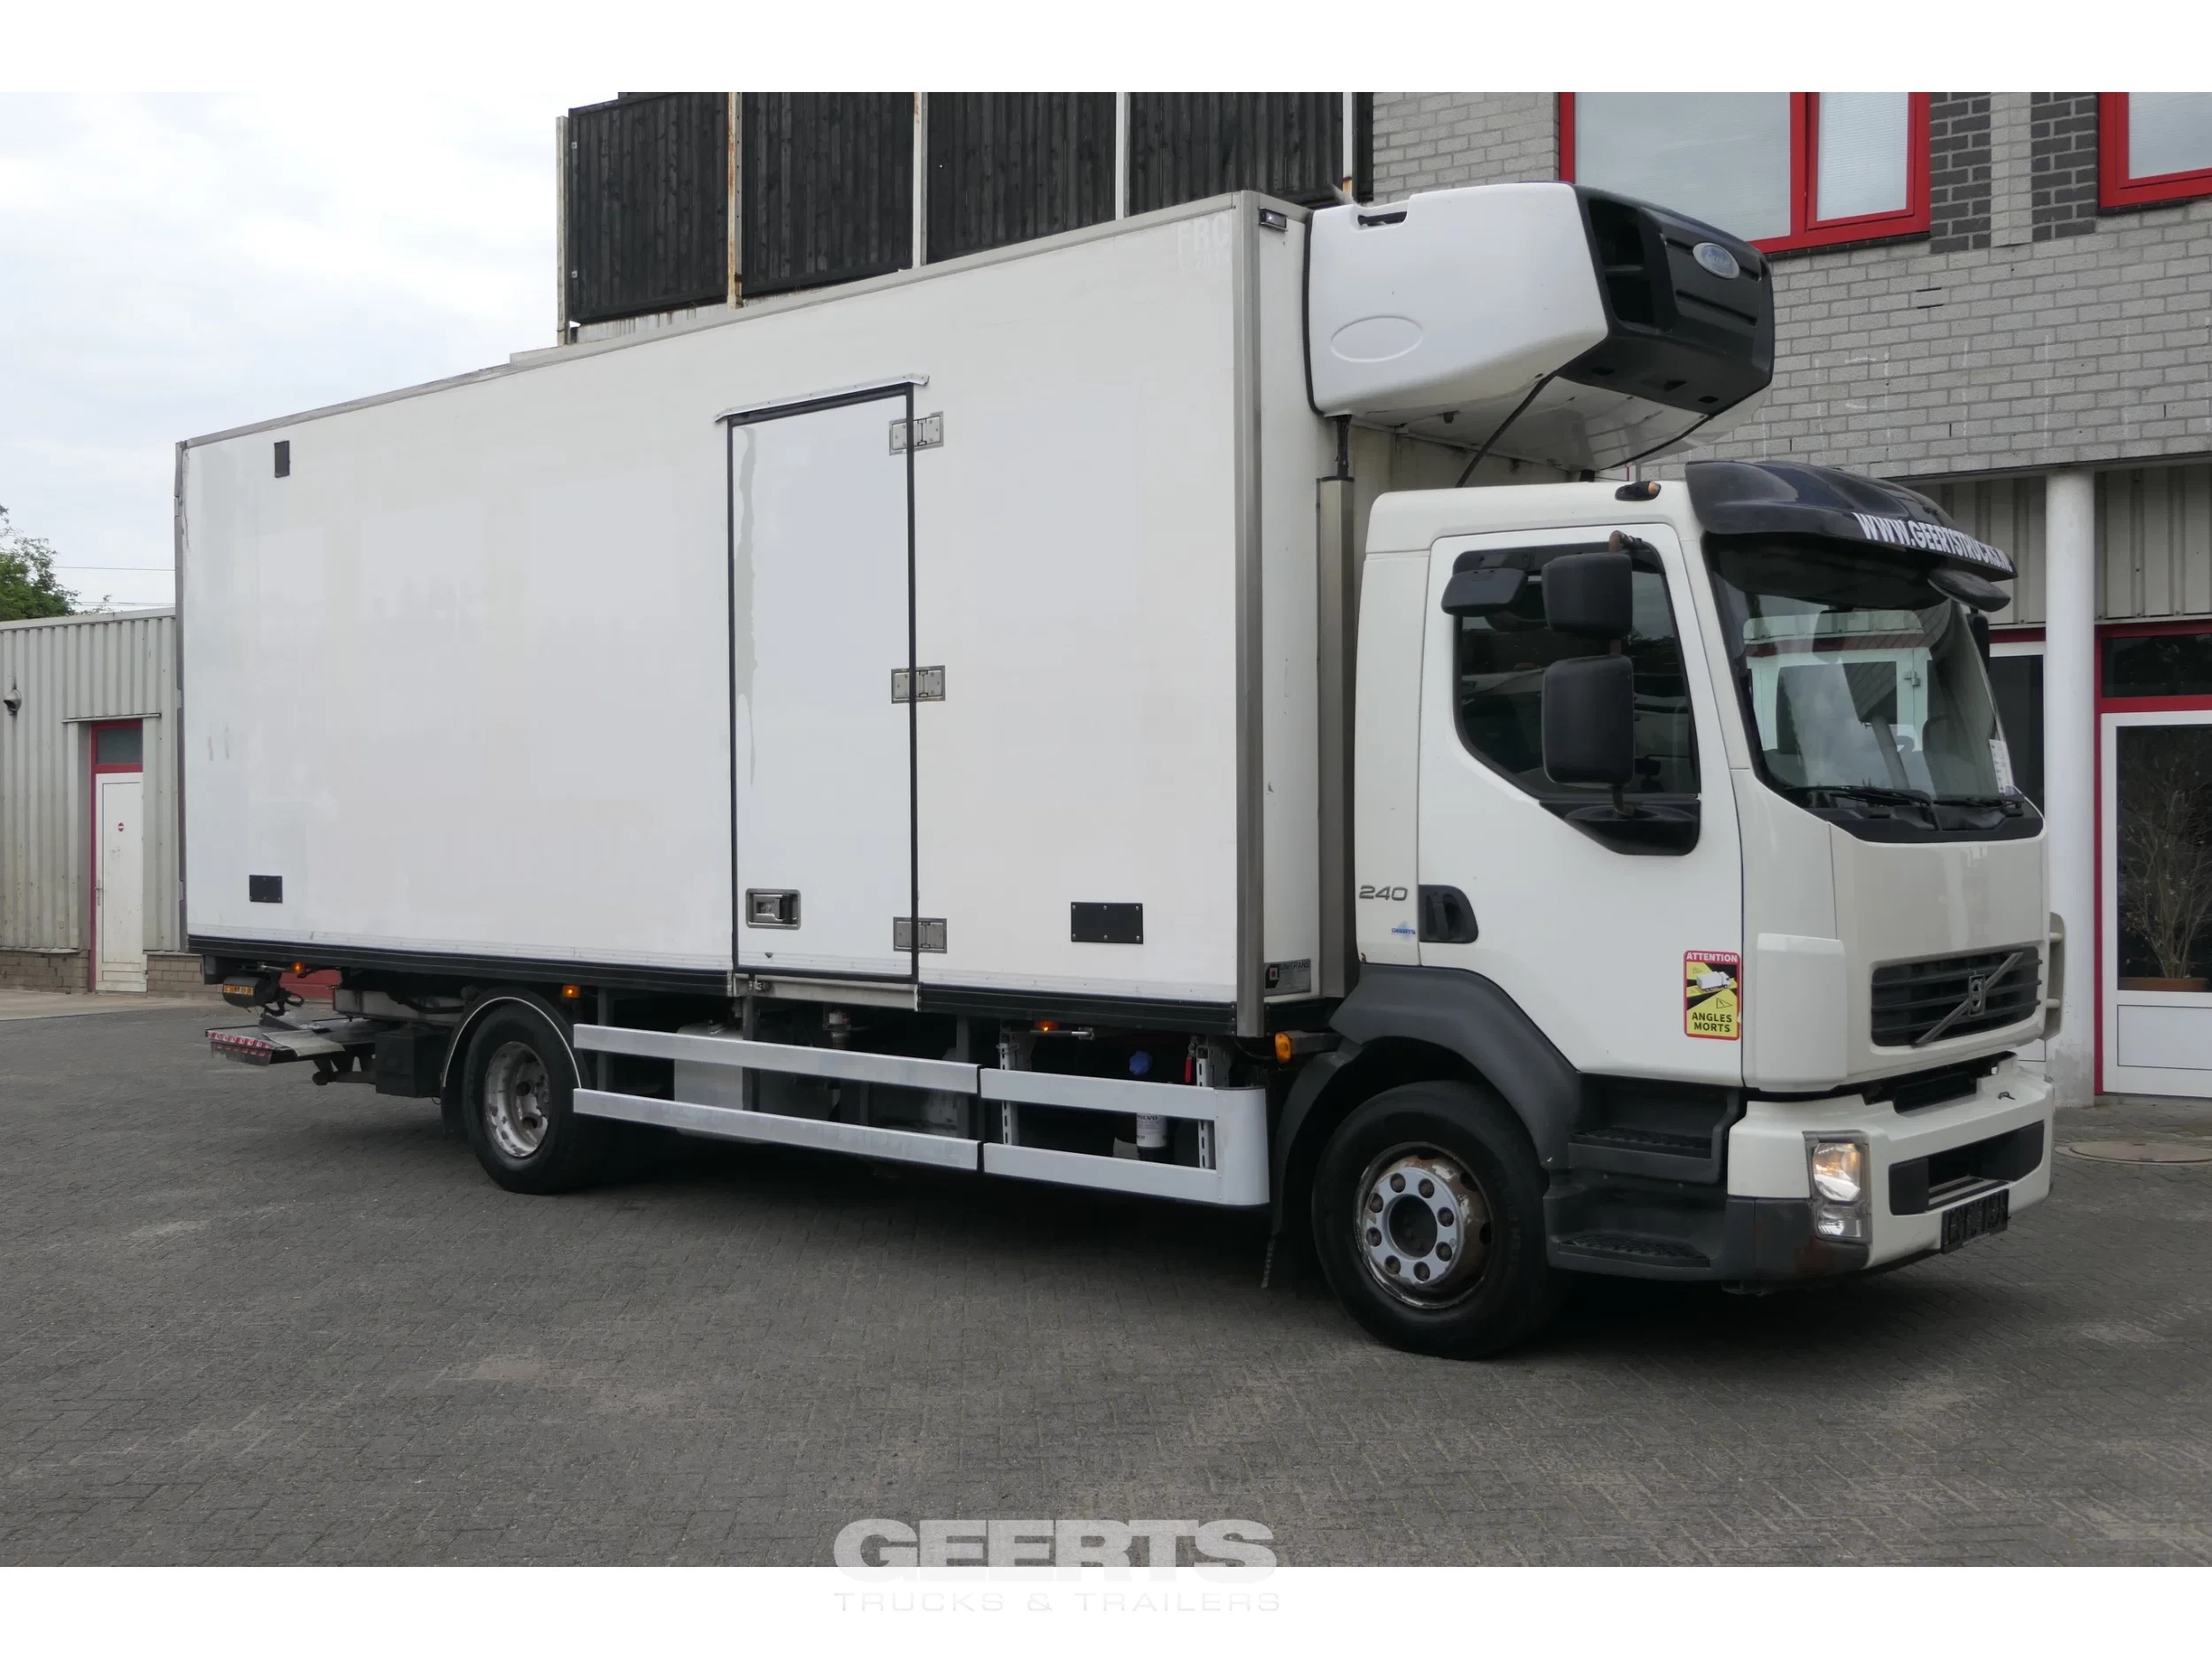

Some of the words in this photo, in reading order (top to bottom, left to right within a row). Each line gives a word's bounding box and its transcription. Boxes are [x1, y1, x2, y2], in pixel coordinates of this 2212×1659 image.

[1177, 212, 1230, 256] FRC
[1359, 885, 1408, 902] 240
[1686, 952, 1738, 963] ATTENTION
[1692, 1011, 1732, 1023] ANGLES
[1694, 1021, 1731, 1033] MORTS
